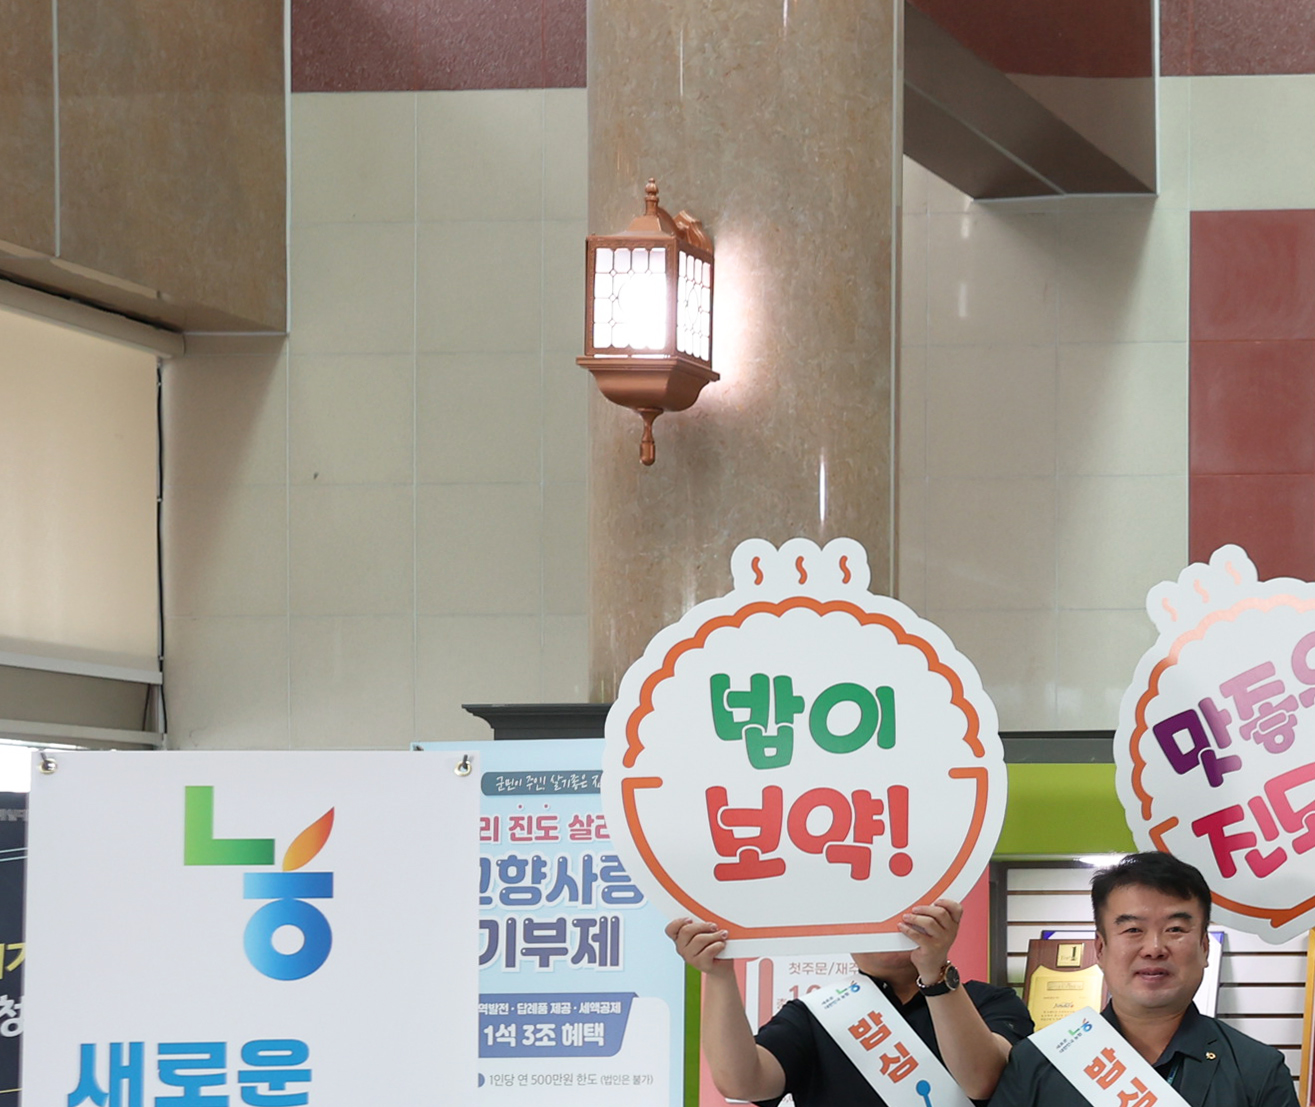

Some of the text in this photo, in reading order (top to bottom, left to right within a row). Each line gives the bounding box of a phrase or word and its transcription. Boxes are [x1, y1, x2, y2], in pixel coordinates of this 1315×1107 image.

[710, 672, 897, 771] 밥이
[508, 815, 560, 842] 진도
[705, 784, 914, 882] 보약!
[479, 916, 620, 968] 기부제
[578, 1001, 621, 1015] 세액공제
[484, 1022, 604, 1046] 1석 3조 혜택
[848, 1010, 919, 1083] 밥심
[531, 1073, 574, 1086] 500만원
[576, 1073, 598, 1086] 한도
